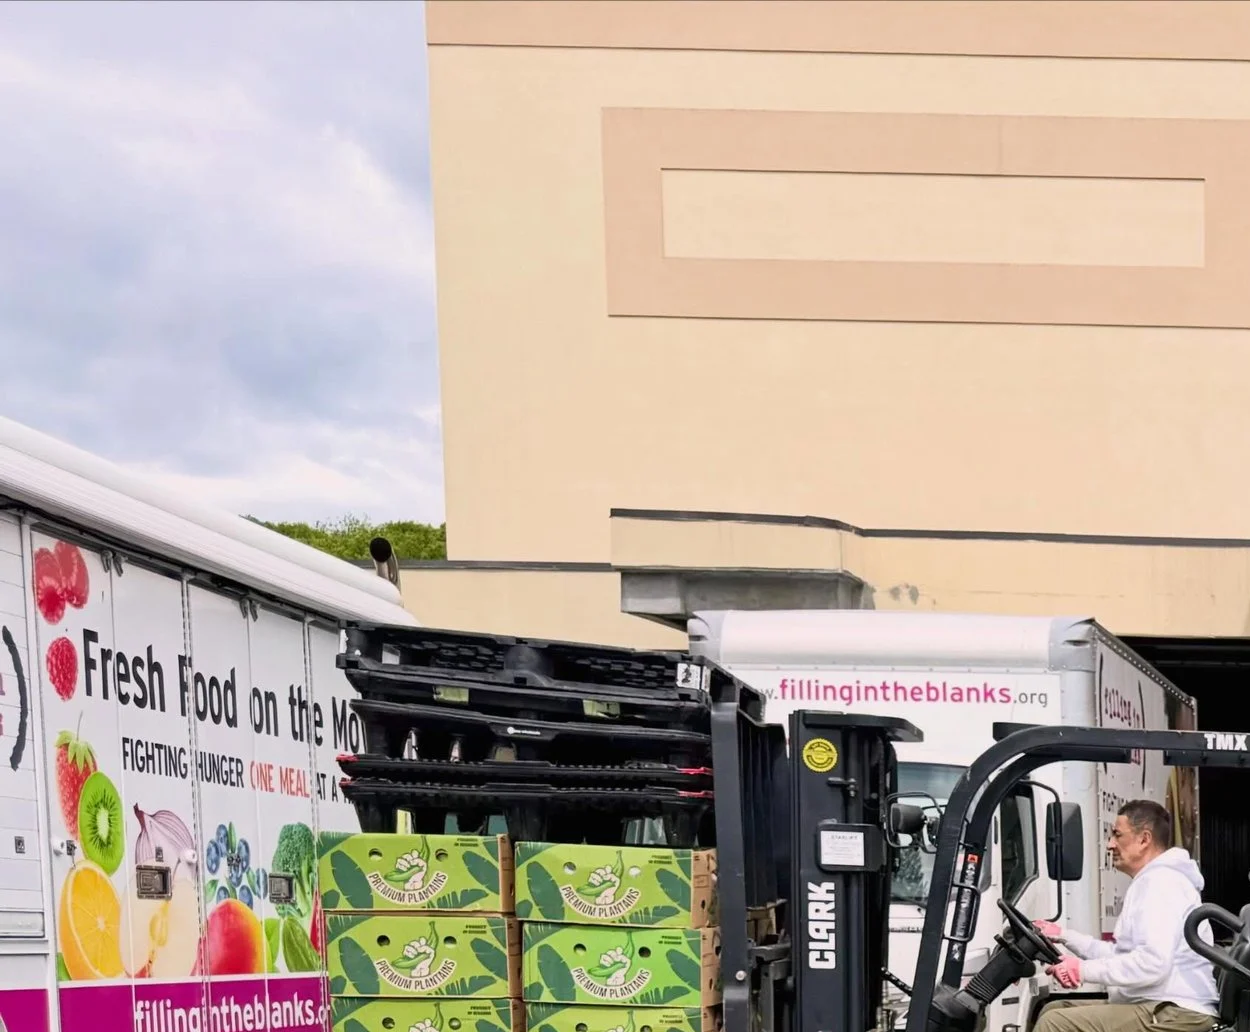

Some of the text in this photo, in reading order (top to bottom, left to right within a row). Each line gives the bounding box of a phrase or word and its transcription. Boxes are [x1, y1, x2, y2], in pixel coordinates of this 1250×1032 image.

[83, 628, 166, 713] Fresh
[178, 654, 238, 729] Food
[250, 686, 279, 737] on
[288, 684, 324, 747] the
[1204, 733, 1248, 751] TMX
[122, 737, 188, 779] FIGHTING
[195, 750, 245, 788] HUNGER
[250, 760, 275, 793] ONE
[279, 766, 311, 798] MEAL
[331, 775, 339, 803] A
[368, 872, 447, 903] PREMIUM PLANTAINS
[561, 886, 640, 918] PREMIUM PLANTAINS
[807, 881, 836, 970] CLARK
[375, 959, 456, 990] PREMIUM PLANTAINS
[572, 968, 650, 998] PREMIUM PLANTAINS
